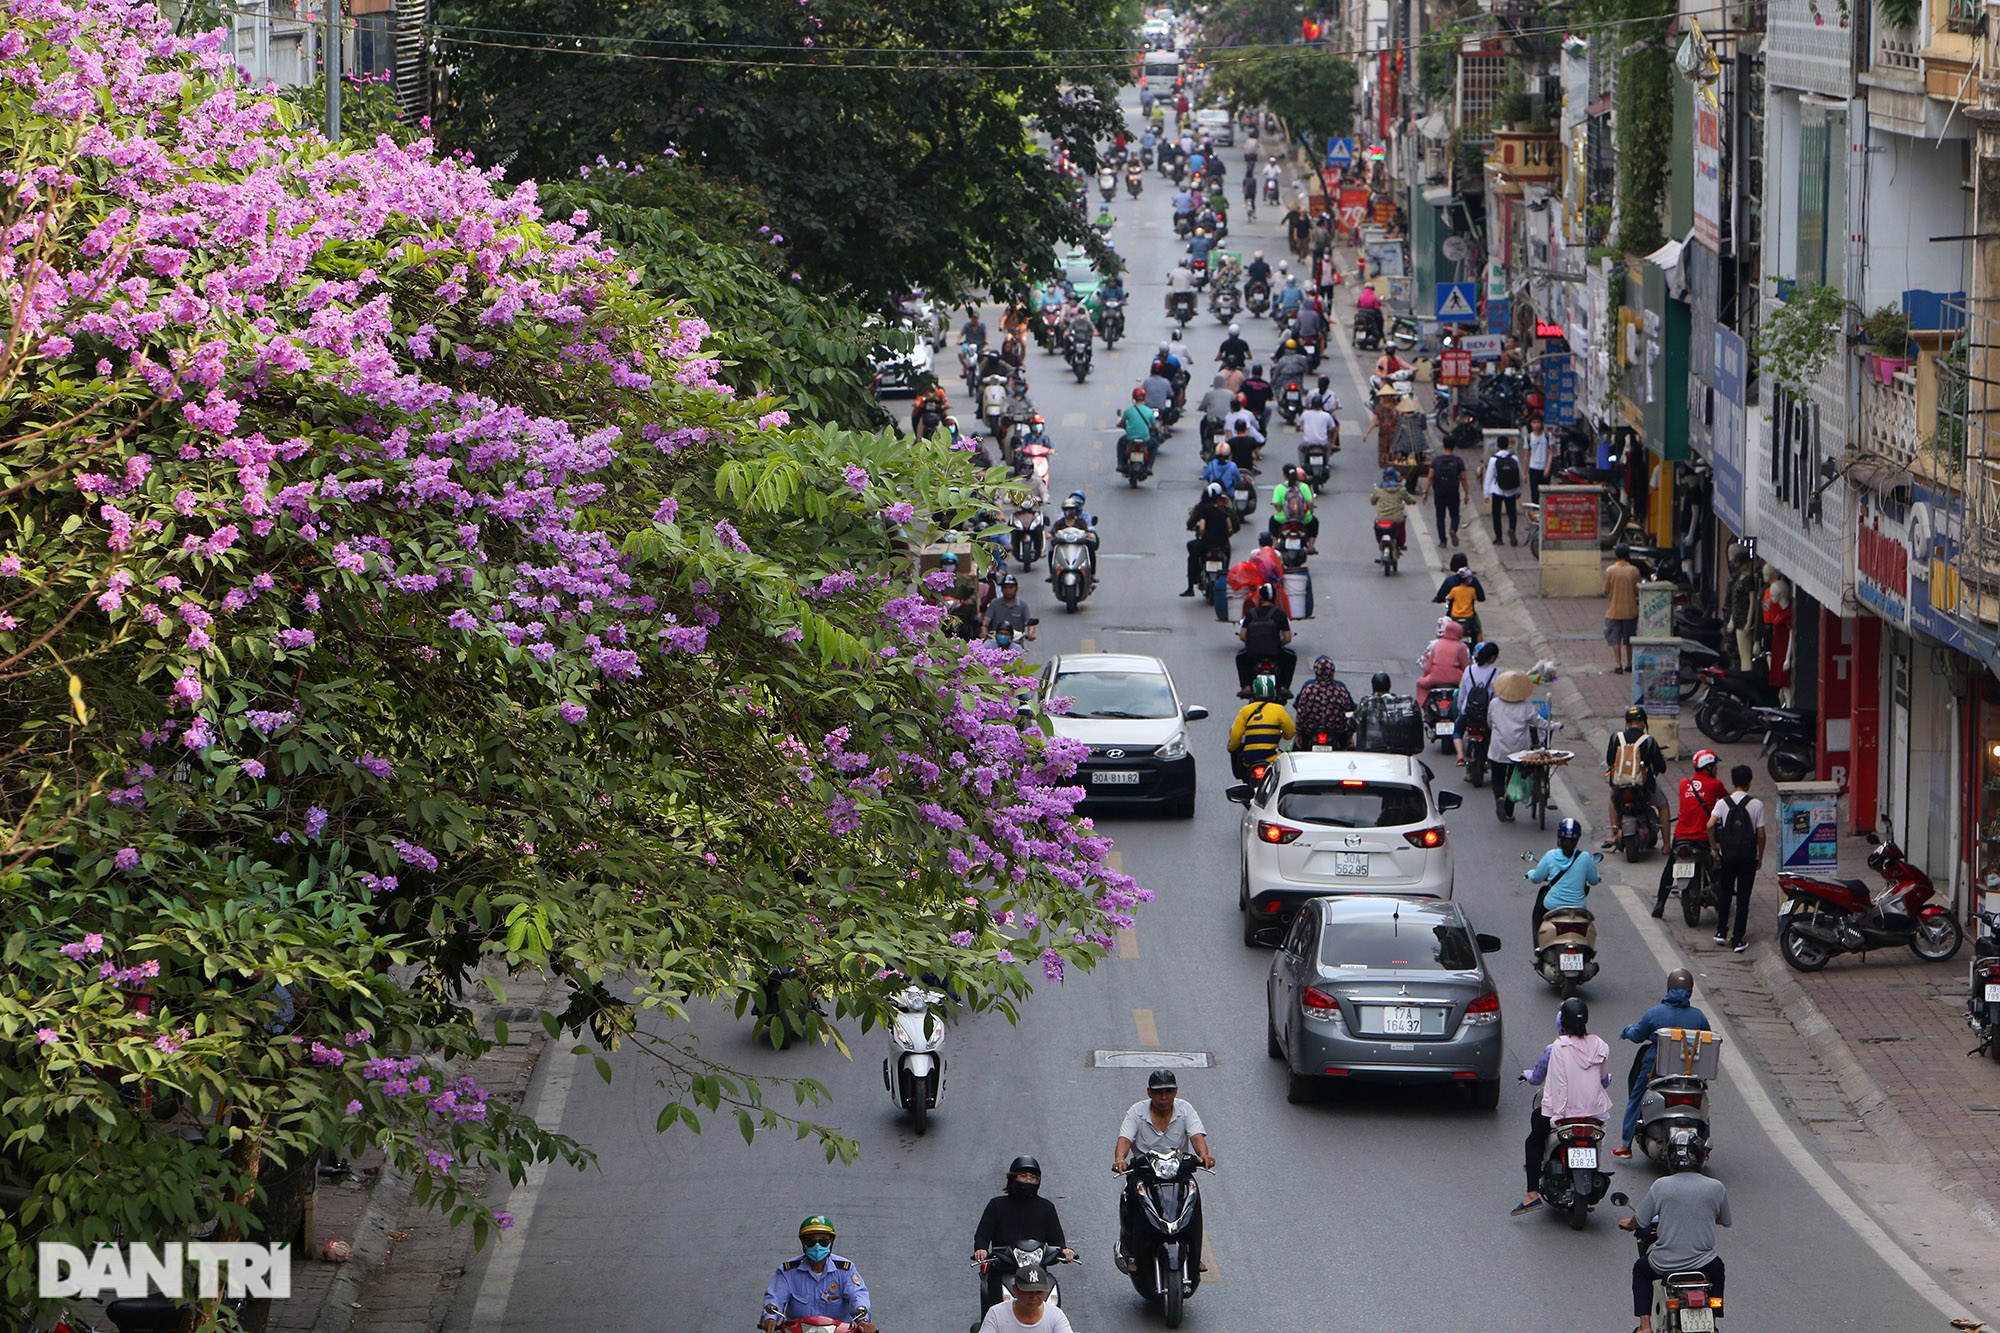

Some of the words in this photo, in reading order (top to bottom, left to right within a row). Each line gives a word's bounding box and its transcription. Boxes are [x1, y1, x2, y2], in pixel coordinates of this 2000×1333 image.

[1466, 341, 1487, 349] BIDV
[1344, 853, 1362, 864] 30A
[1336, 863, 1368, 875] 562.95
[1394, 1008, 1413, 1019] 17A
[1386, 1019, 1420, 1032] 164.37
[1572, 1149, 1593, 1158] 29-T1
[1570, 1158, 1596, 1167] 838.25
